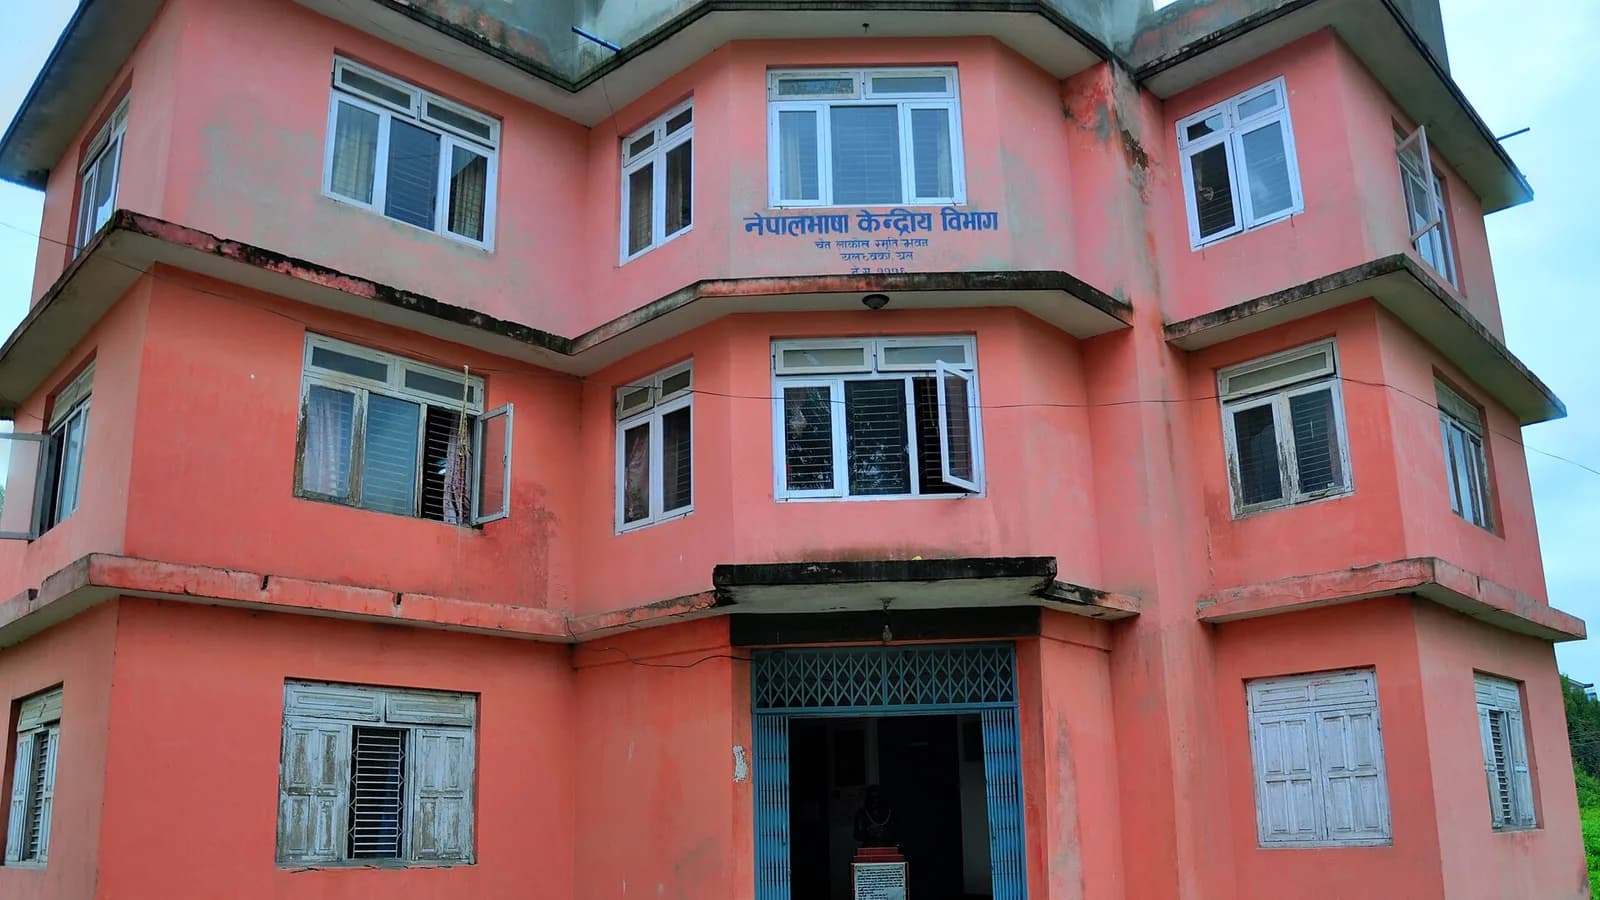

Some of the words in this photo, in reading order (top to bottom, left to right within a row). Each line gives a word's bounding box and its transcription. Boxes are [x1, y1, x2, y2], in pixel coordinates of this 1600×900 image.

[743, 212, 849, 236] नेपालभाषा
[856, 207, 933, 236] केन्द्रीय
[941, 207, 999, 231] विभाग
[901, 238, 928, 248] भवन
